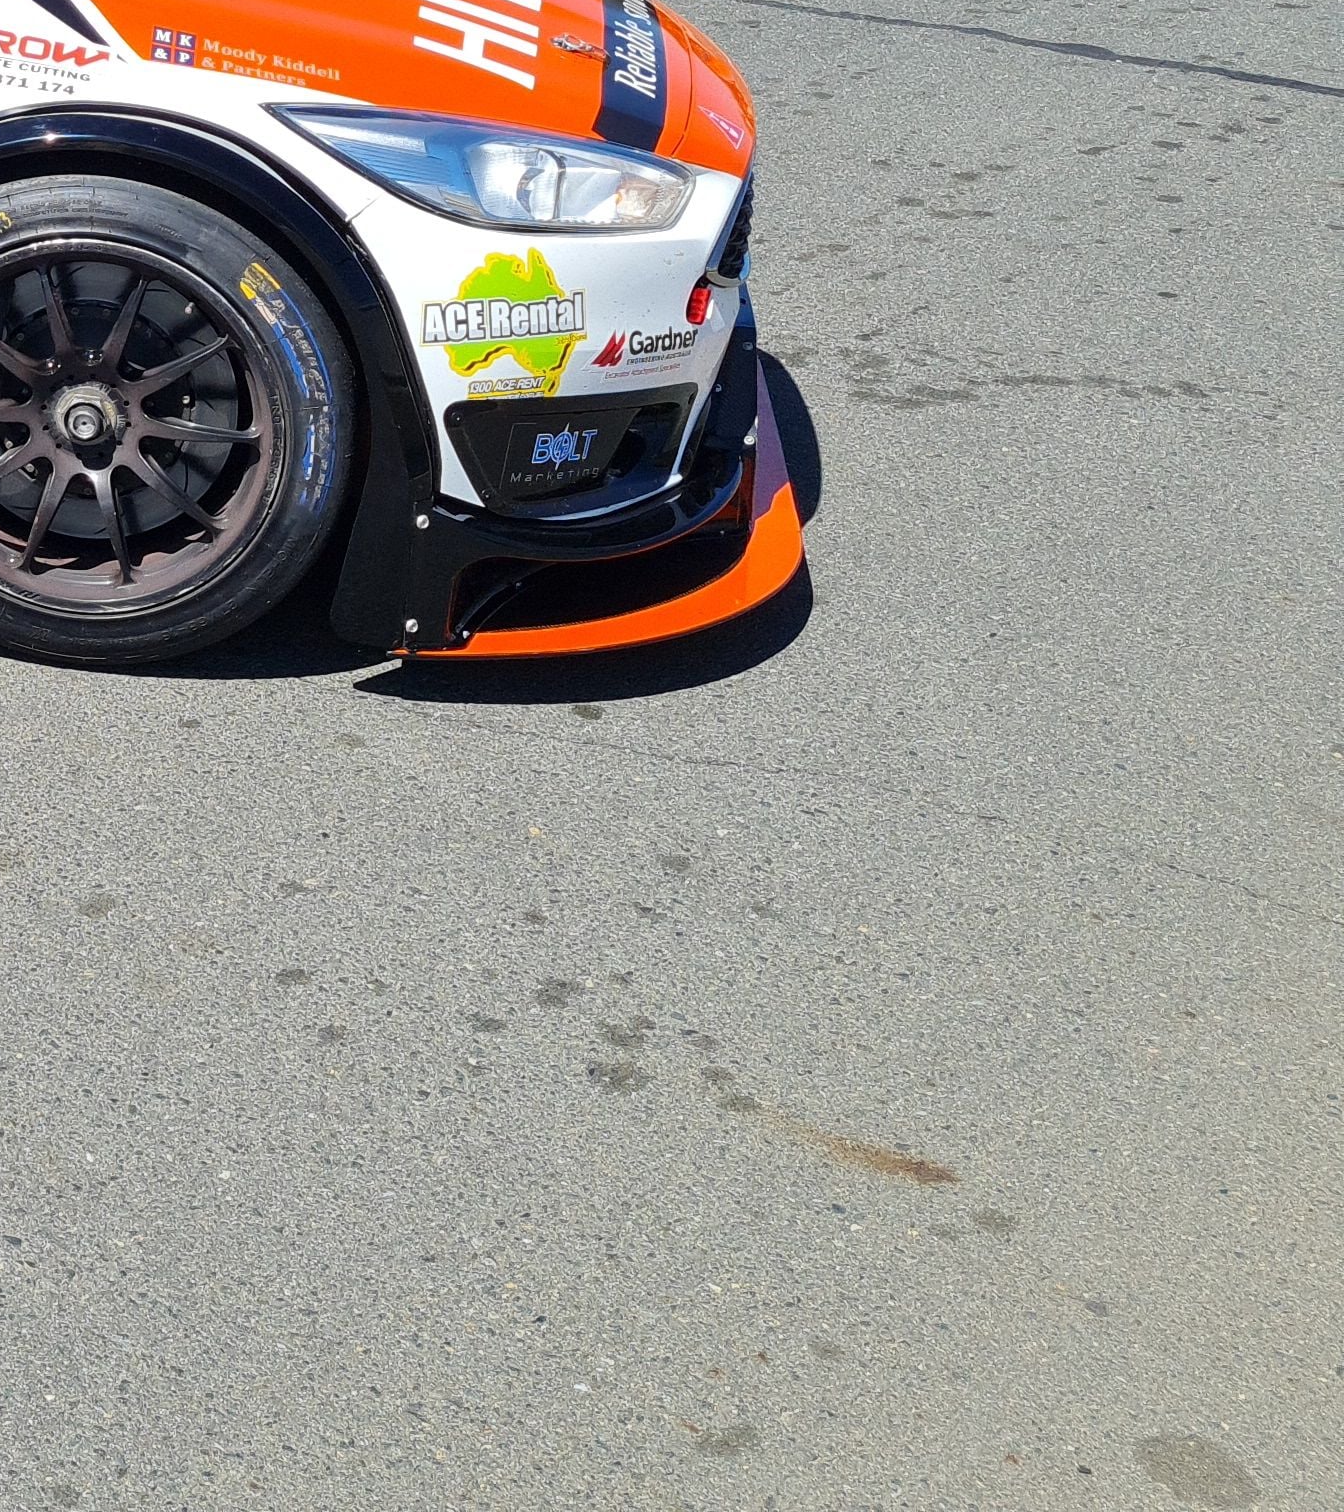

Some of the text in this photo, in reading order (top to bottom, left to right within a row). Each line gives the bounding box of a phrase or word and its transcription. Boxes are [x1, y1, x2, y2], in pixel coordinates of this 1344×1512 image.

[155, 28, 193, 48] M K
[155, 47, 192, 64] & P
[203, 38, 341, 81] Moody Kiddell
[614, 20, 657, 99] Reliable
[18, 63, 91, 82] CUTTING
[201, 56, 307, 87] & Partners
[37, 80, 75, 95] 174
[423, 292, 585, 344] ACE Rental
[629, 326, 699, 356] Gardner
[469, 376, 546, 394] 1300 ACE RENT
[531, 429, 598, 465] BOLT
[511, 465, 600, 485] Marketing
